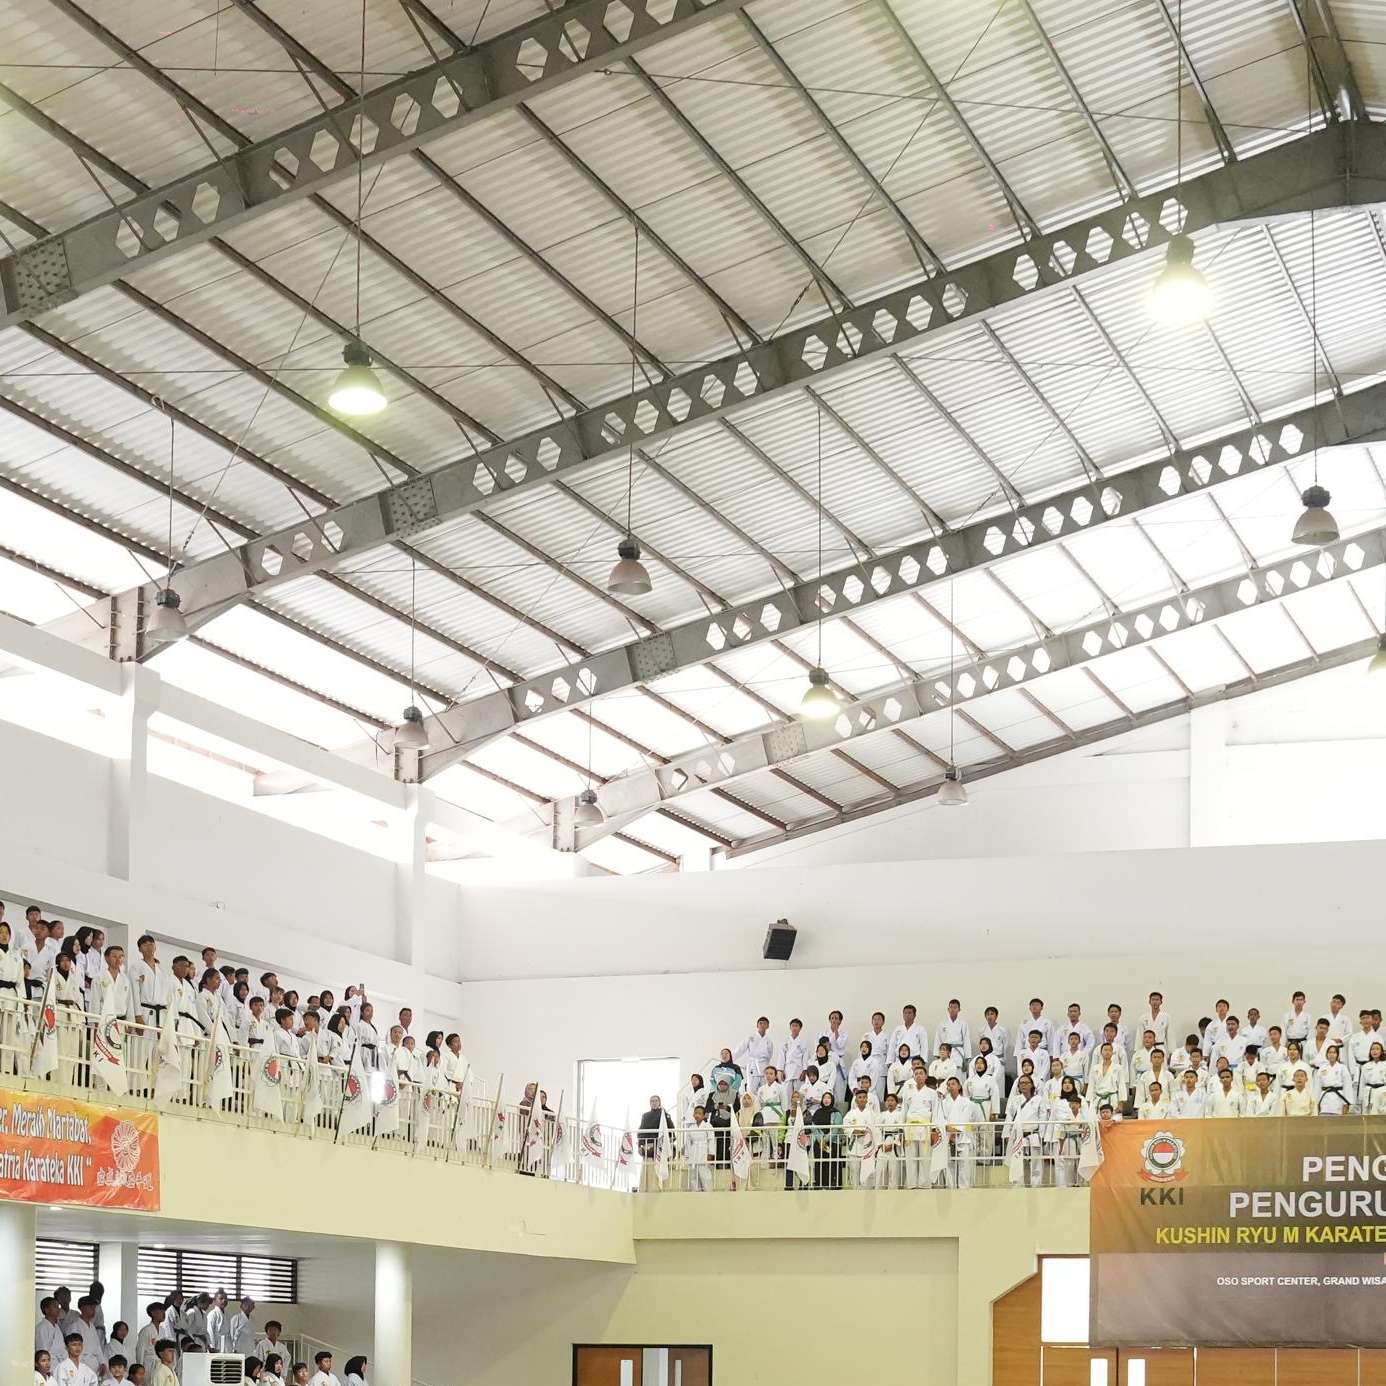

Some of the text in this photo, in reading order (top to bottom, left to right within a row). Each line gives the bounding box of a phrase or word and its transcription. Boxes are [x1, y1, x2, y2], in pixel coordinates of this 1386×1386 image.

[12, 1103, 46, 1139] Meraih
[47, 1107, 92, 1146] Martabat,
[22, 1152, 65, 1185] Karateka
[67, 1154, 85, 1186] KKI
[1140, 1187, 1184, 1206] KKI
[1155, 1226, 1230, 1244] KUSHIN
[1236, 1226, 1278, 1244] RYU
[1283, 1227, 1299, 1243] M
[1216, 1276, 1239, 1286] OSO
[1240, 1276, 1276, 1286] SPORT
[1277, 1276, 1321, 1287] CENTER,
[1323, 1276, 1360, 1286] GRAND
